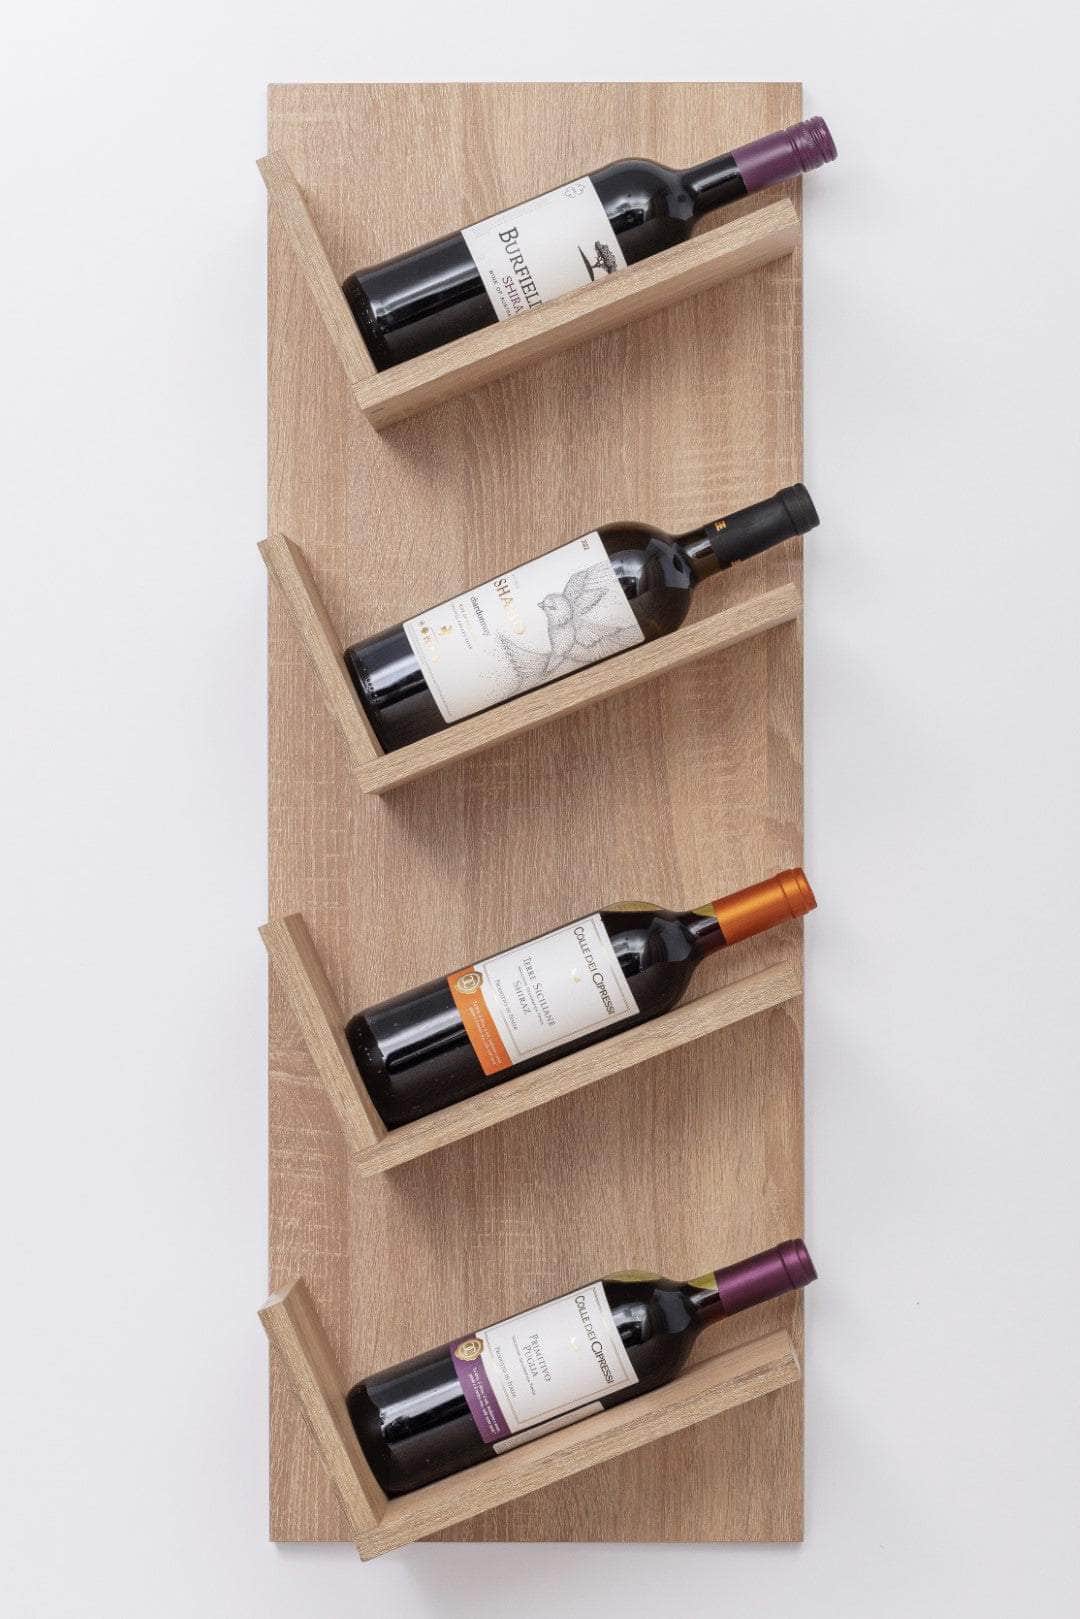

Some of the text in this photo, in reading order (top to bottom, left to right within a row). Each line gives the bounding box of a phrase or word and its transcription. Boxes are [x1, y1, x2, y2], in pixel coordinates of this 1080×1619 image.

[499, 226, 543, 309] BURFIEL
[502, 276, 524, 314] SHIRA
[592, 972, 616, 1015] CIPRESSI
[591, 1341, 615, 1384] CIPRESSI
